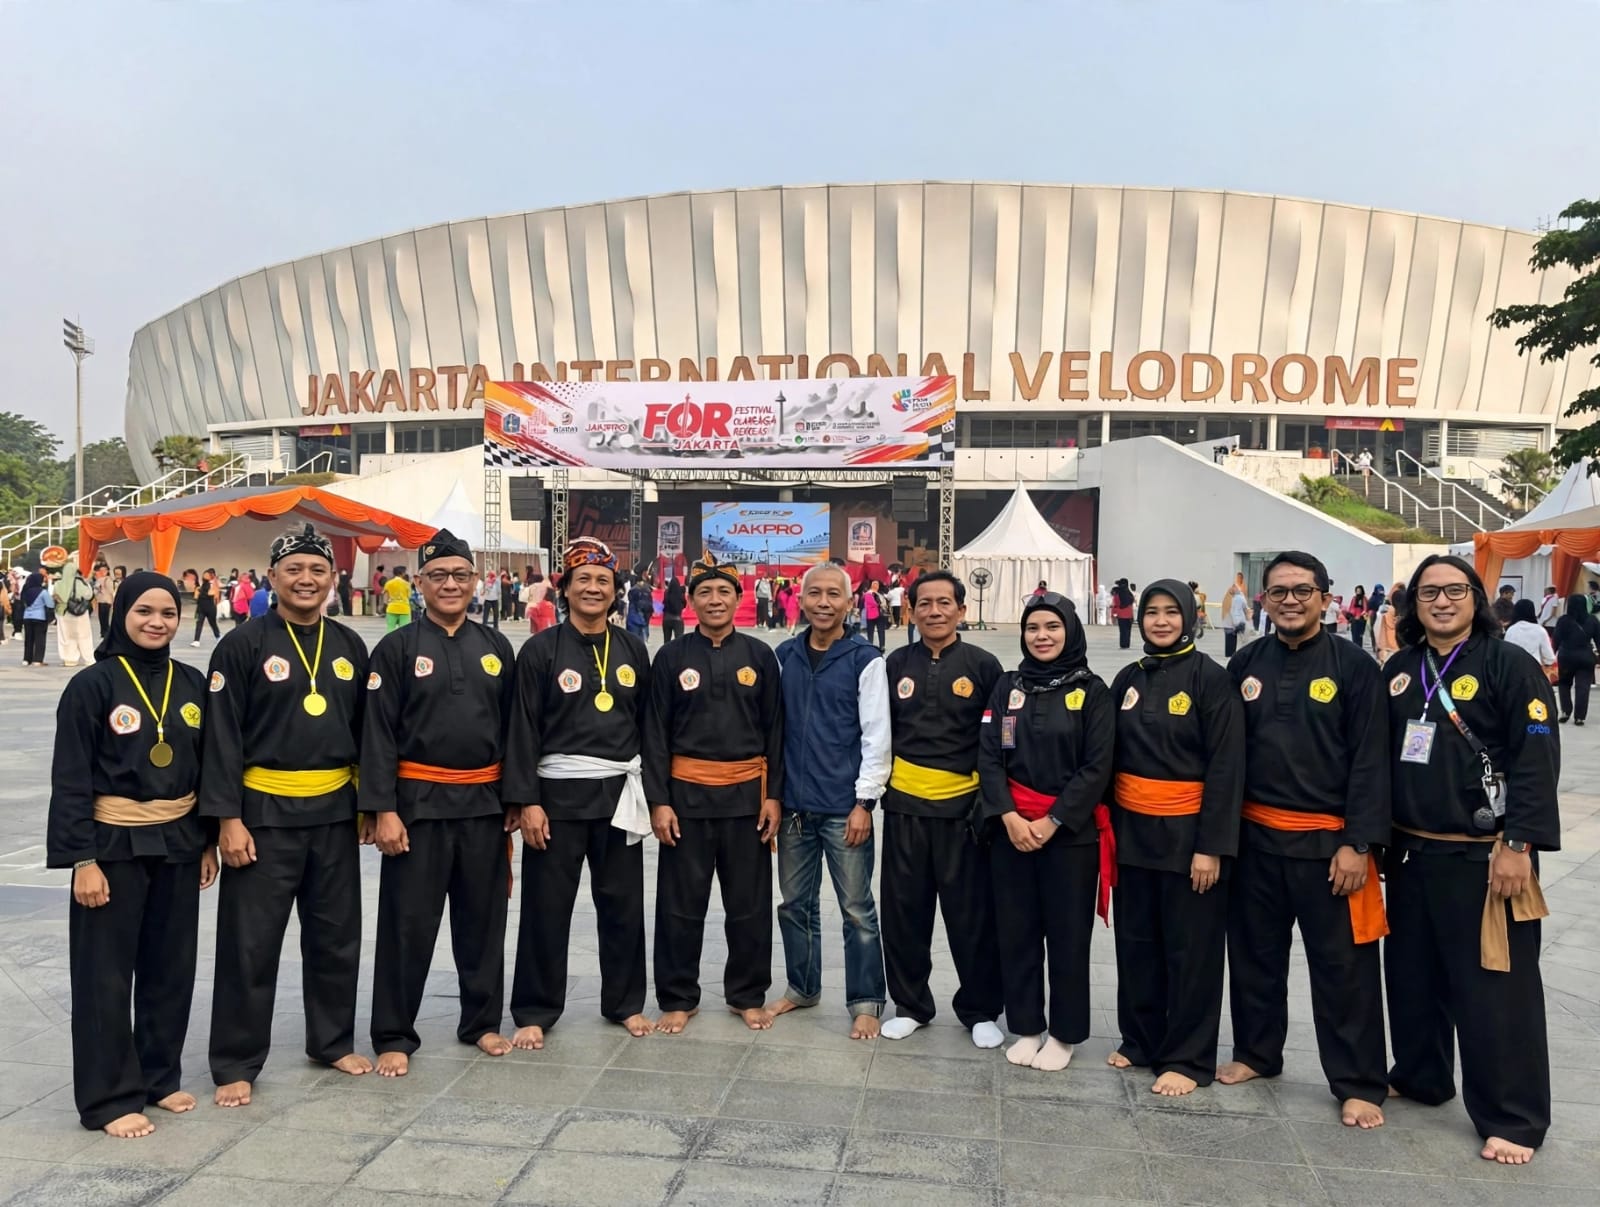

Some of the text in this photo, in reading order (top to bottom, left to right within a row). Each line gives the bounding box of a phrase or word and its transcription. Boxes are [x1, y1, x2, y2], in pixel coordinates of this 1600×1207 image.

[302, 363, 485, 415] JAKARTA
[1009, 350, 1418, 406] VELODROME
[734, 406, 775, 415] FESTIVAL
[643, 402, 733, 439] FOR
[675, 440, 739, 450] JAKARTA
[727, 523, 804, 536] JAKPRO
